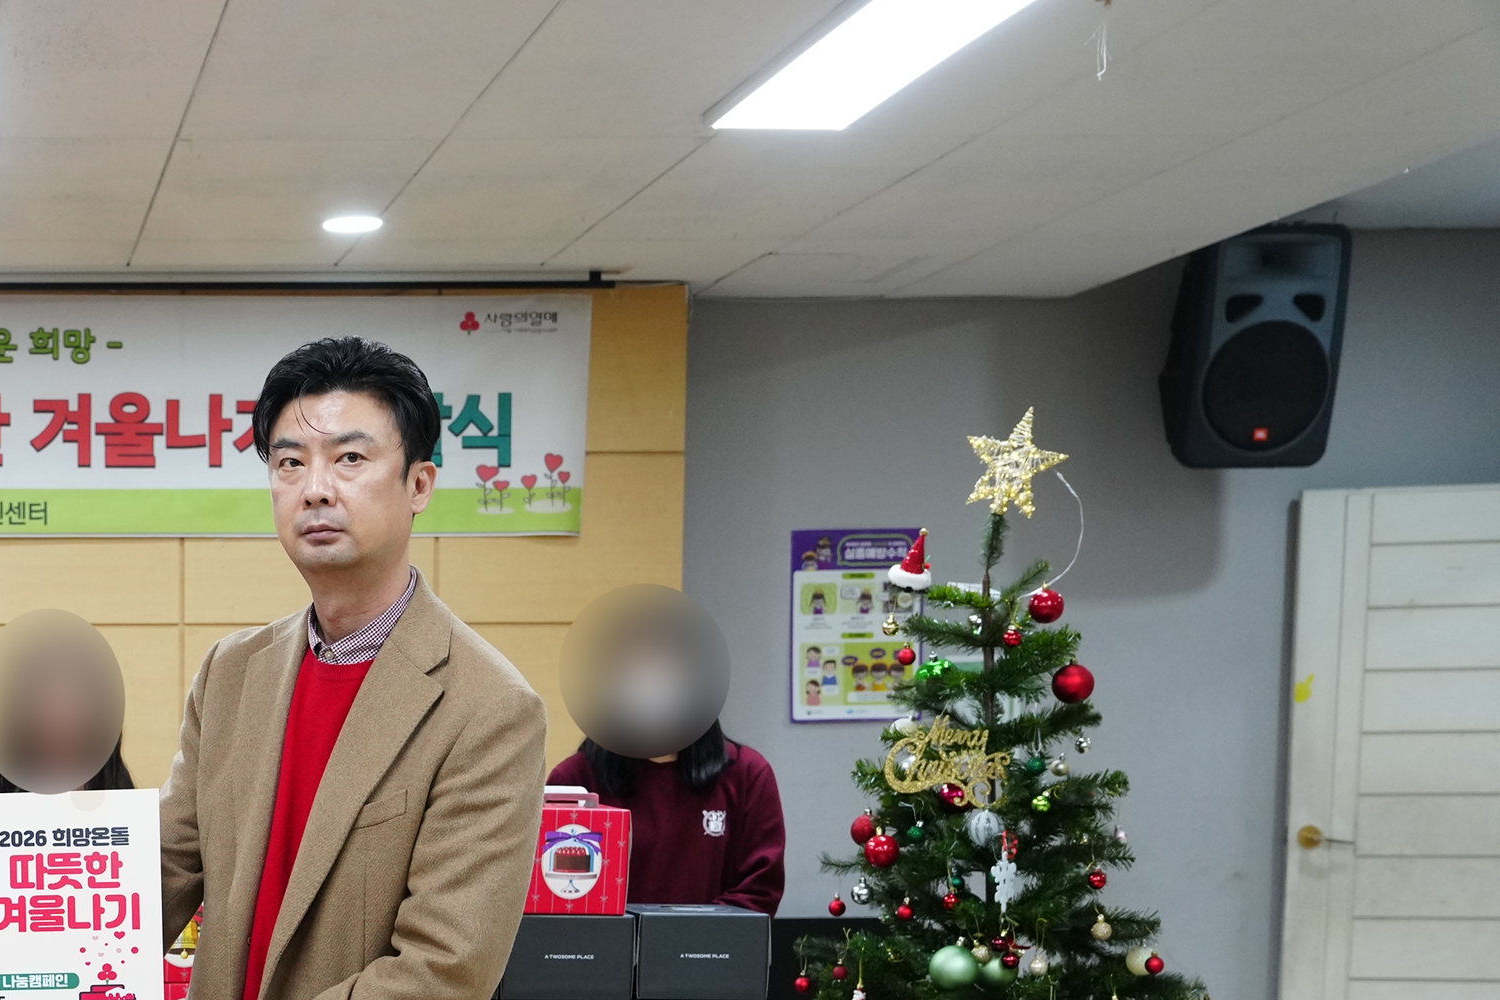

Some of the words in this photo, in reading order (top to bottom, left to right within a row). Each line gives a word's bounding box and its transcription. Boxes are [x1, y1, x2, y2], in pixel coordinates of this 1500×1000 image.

[484, 311, 558, 328] 사랑의열매
[29, 327, 96, 364] 희망
[0, 830, 47, 847] 2026
[52, 826, 130, 847] 희망온돌
[9, 851, 123, 890] 따뜻한
[2, 973, 69, 989] 나눔캠페인
